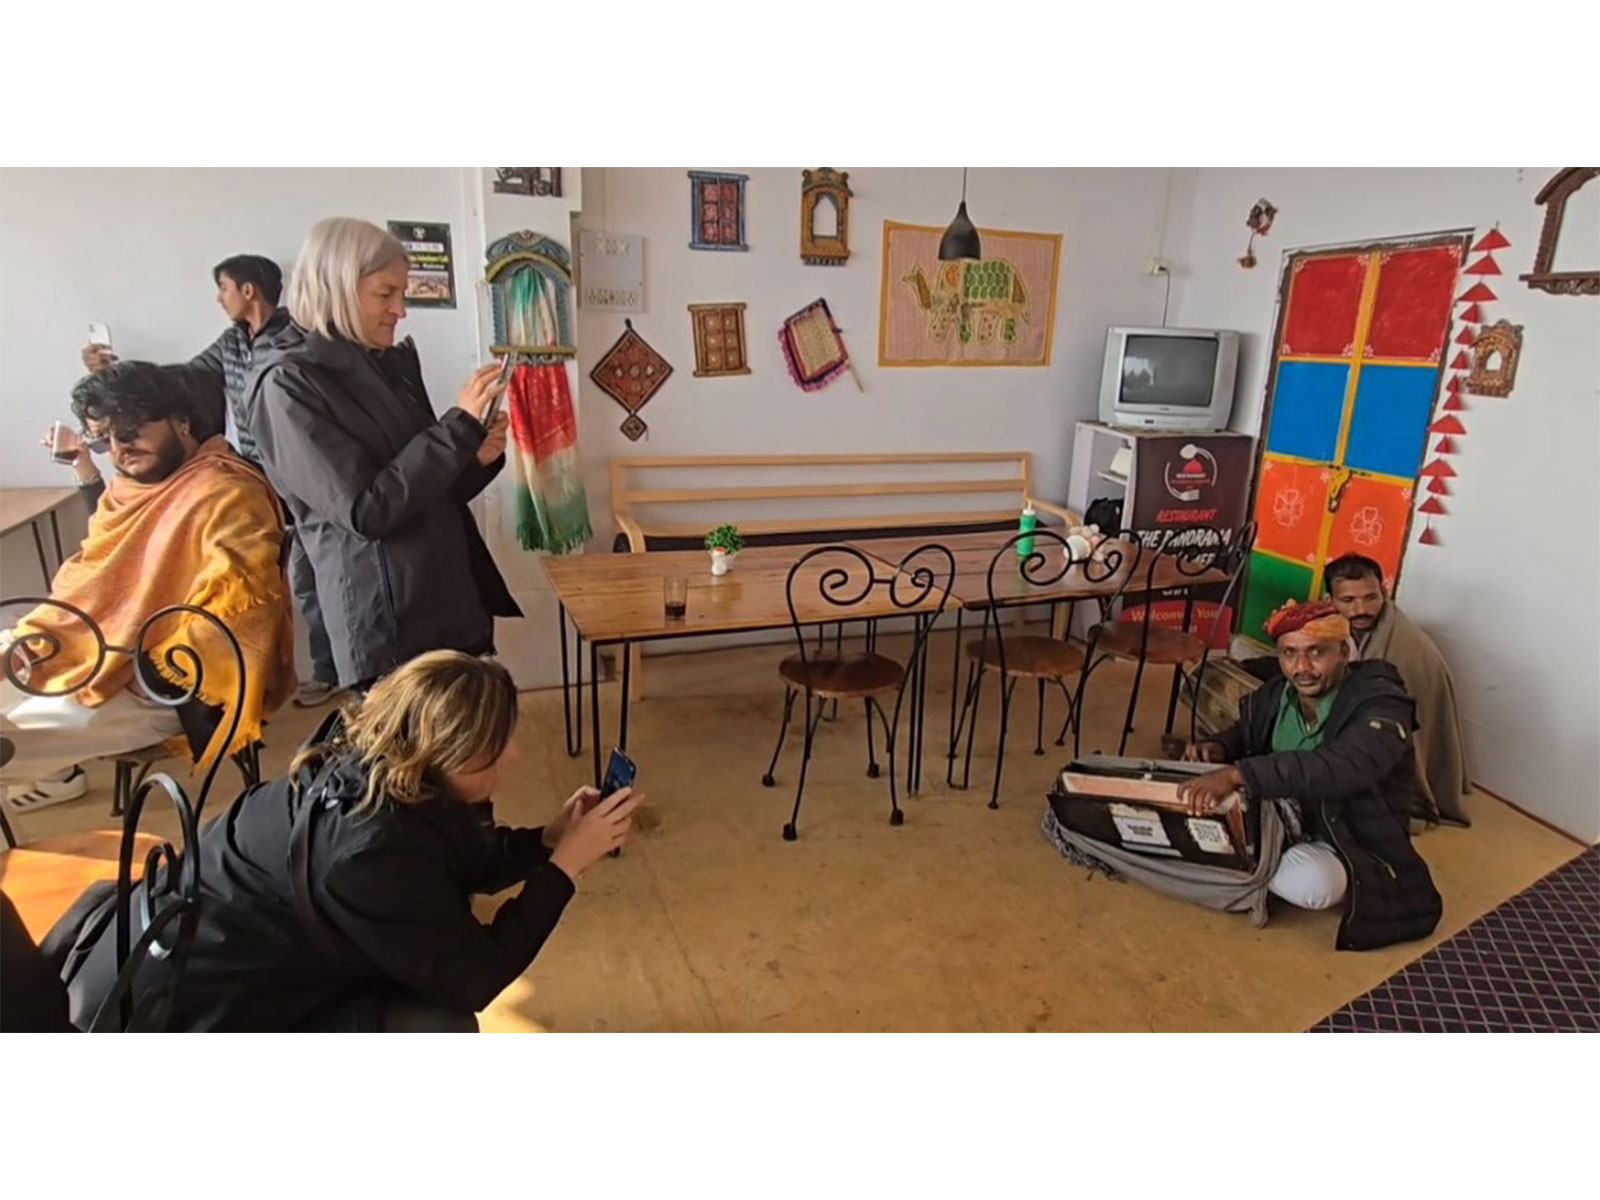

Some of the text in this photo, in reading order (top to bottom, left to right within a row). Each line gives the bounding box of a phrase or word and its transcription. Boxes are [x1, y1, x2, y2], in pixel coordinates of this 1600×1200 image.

[1156, 508, 1218, 522] RESTAURANT
[1137, 530, 1162, 548] THE
[1132, 608, 1191, 622] Wlcom
